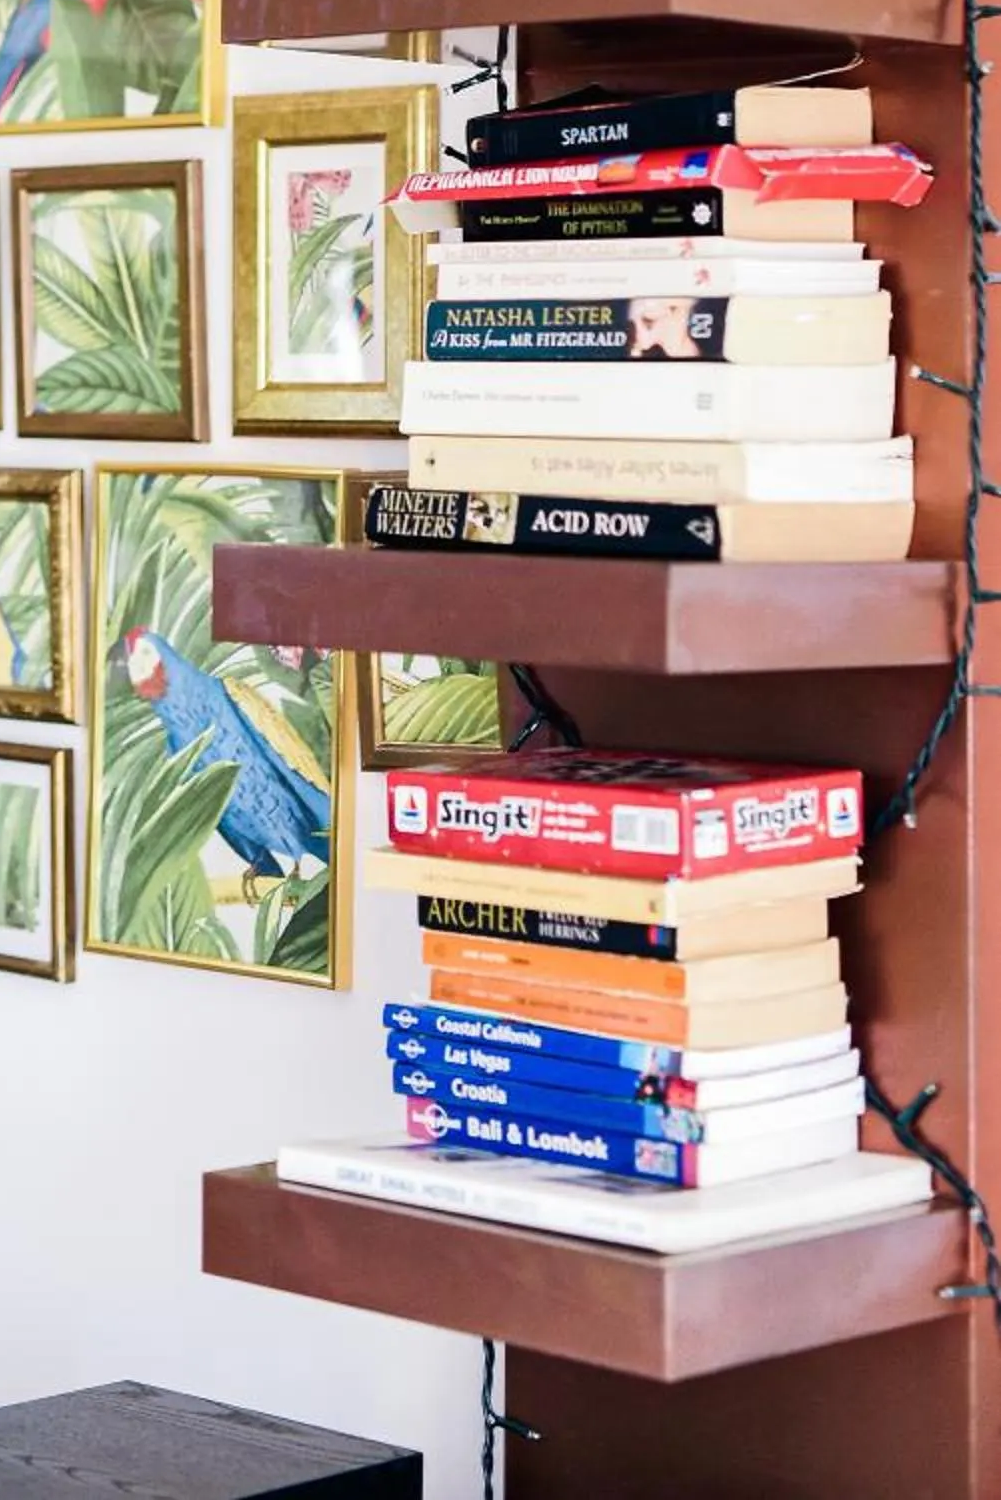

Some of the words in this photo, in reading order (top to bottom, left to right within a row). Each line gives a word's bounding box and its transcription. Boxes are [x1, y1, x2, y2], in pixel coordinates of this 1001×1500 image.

[560, 123, 629, 146] SPARTAN
[548, 203, 570, 217] THE
[572, 200, 644, 216] DAMNATION
[563, 222, 578, 236] OF
[580, 220, 628, 235] PYTHOS
[446, 308, 536, 328] NATASHA
[541, 306, 614, 327] LESTER
[449, 332, 481, 348] KISS
[482, 329, 508, 350] from
[509, 332, 534, 348] MR
[536, 330, 628, 348] FITZGERALD
[377, 490, 459, 515] MINETTE
[376, 513, 457, 540] WALTERS
[531, 508, 590, 536] ACID
[593, 510, 650, 538] ROW
[427, 897, 528, 935] ARCHER
[538, 923, 600, 943] HERRINGS
[435, 1015, 482, 1040] Coastal
[482, 1023, 543, 1049] California
[444, 1045, 469, 1065] Las
[470, 1053, 511, 1074] Vegas
[451, 1077, 508, 1106] Croatia
[466, 1116, 502, 1141] Bali
[506, 1124, 523, 1145] &
[527, 1126, 609, 1161] Lombok
